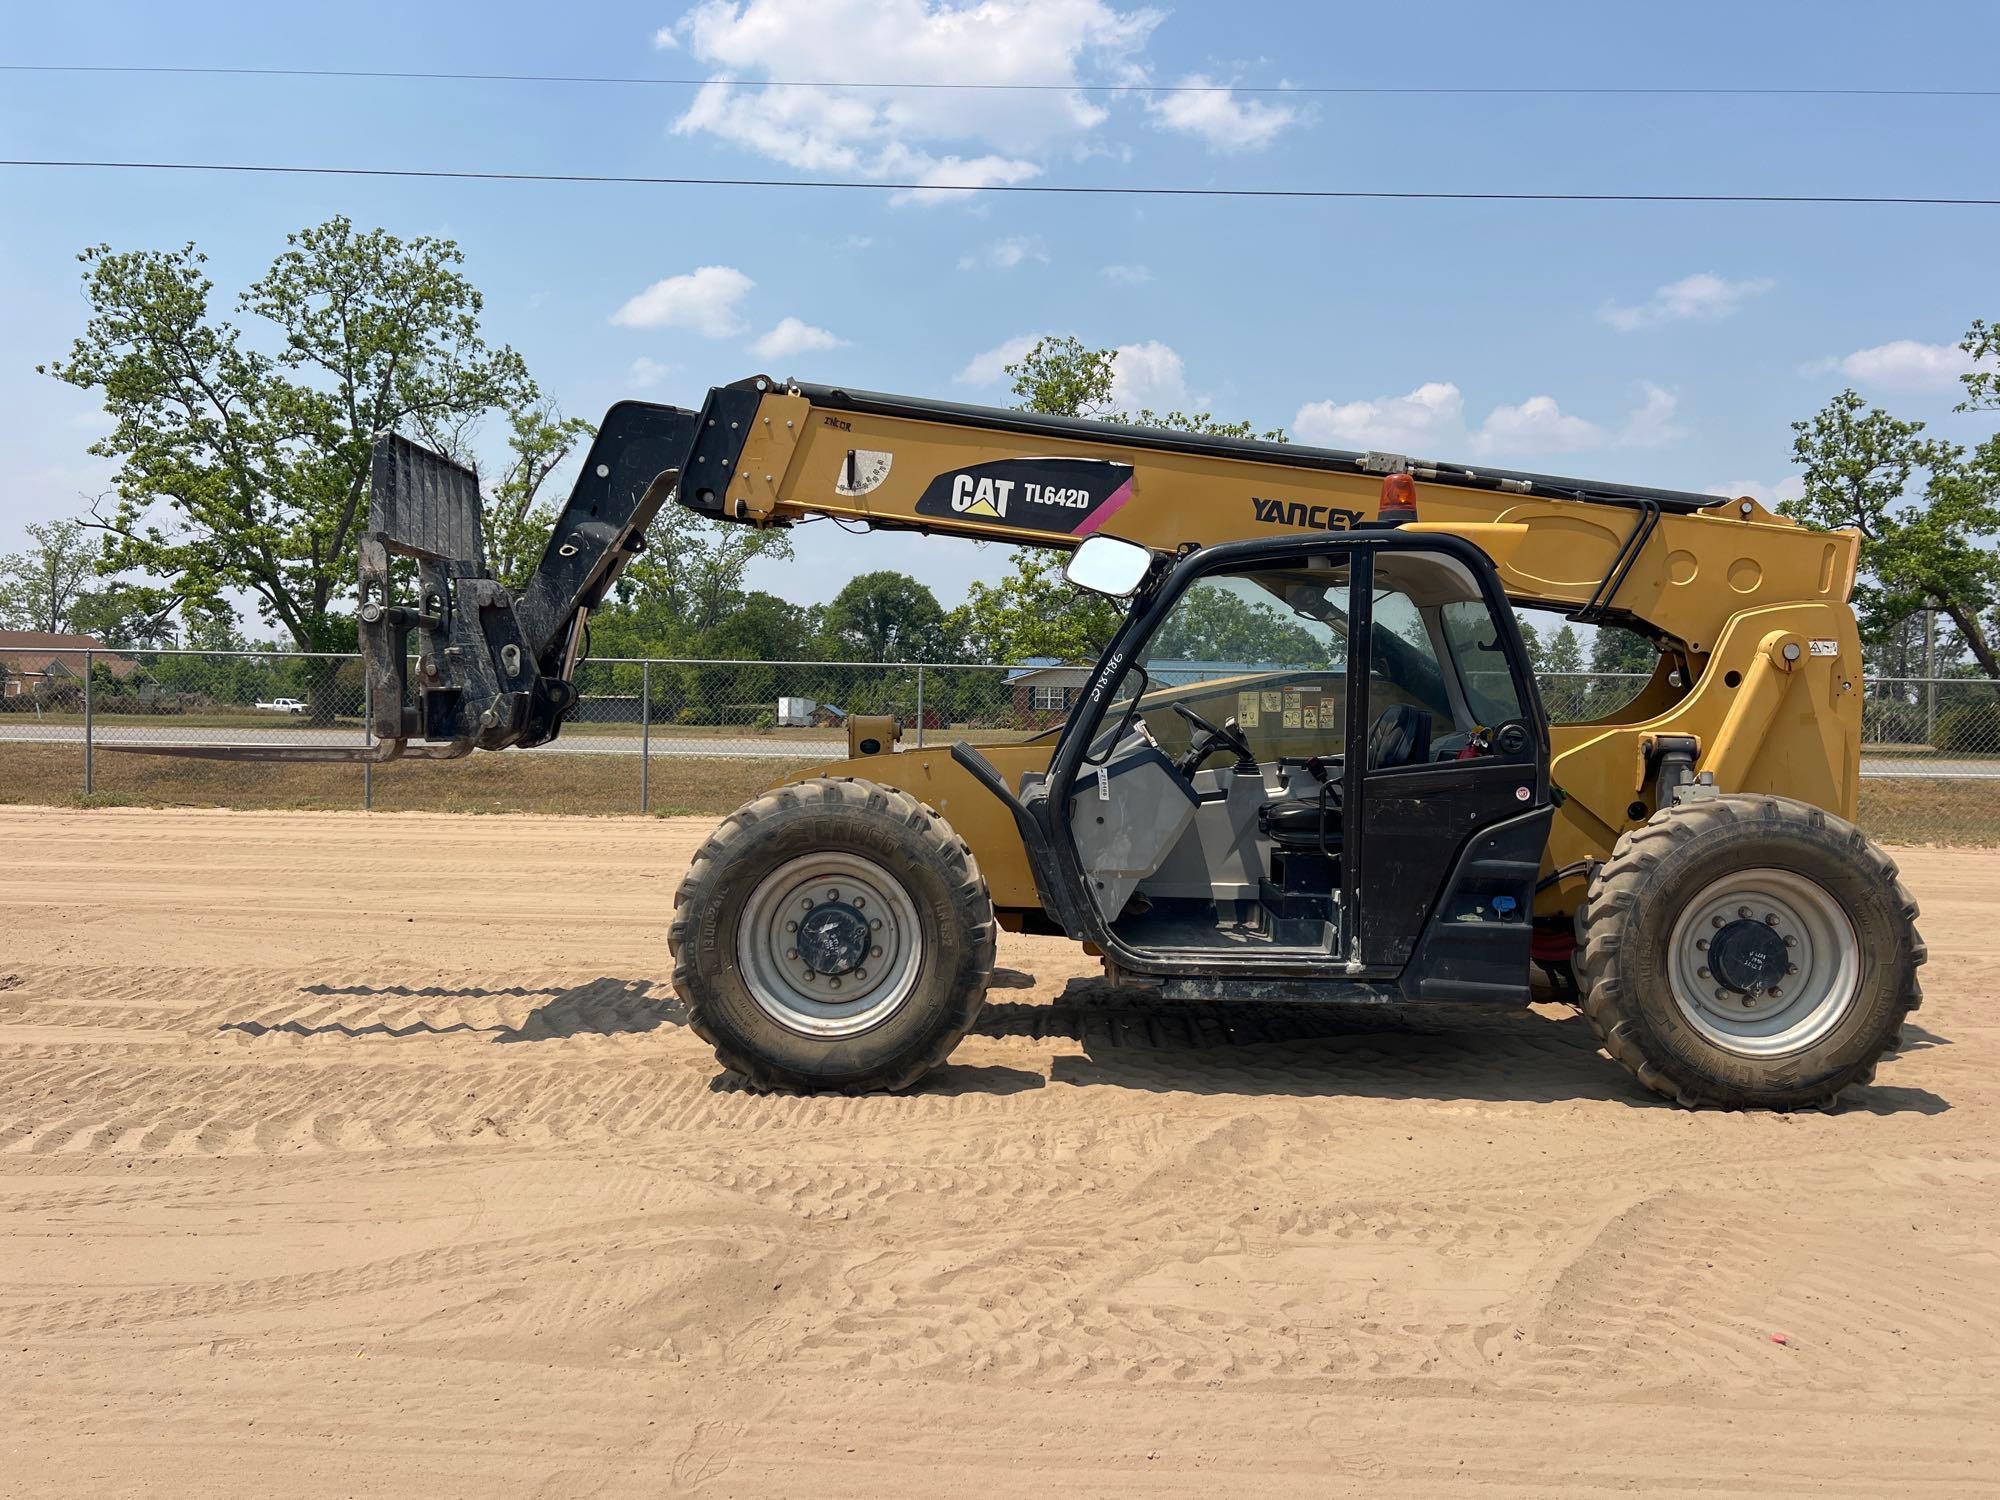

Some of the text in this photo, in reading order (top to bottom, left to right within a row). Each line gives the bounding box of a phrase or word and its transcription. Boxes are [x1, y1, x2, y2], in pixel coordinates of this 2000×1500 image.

[951, 474, 1090, 518] CAT TL642D
[1252, 497, 1365, 531] YANCEY
[1091, 653, 1123, 703] 218486
